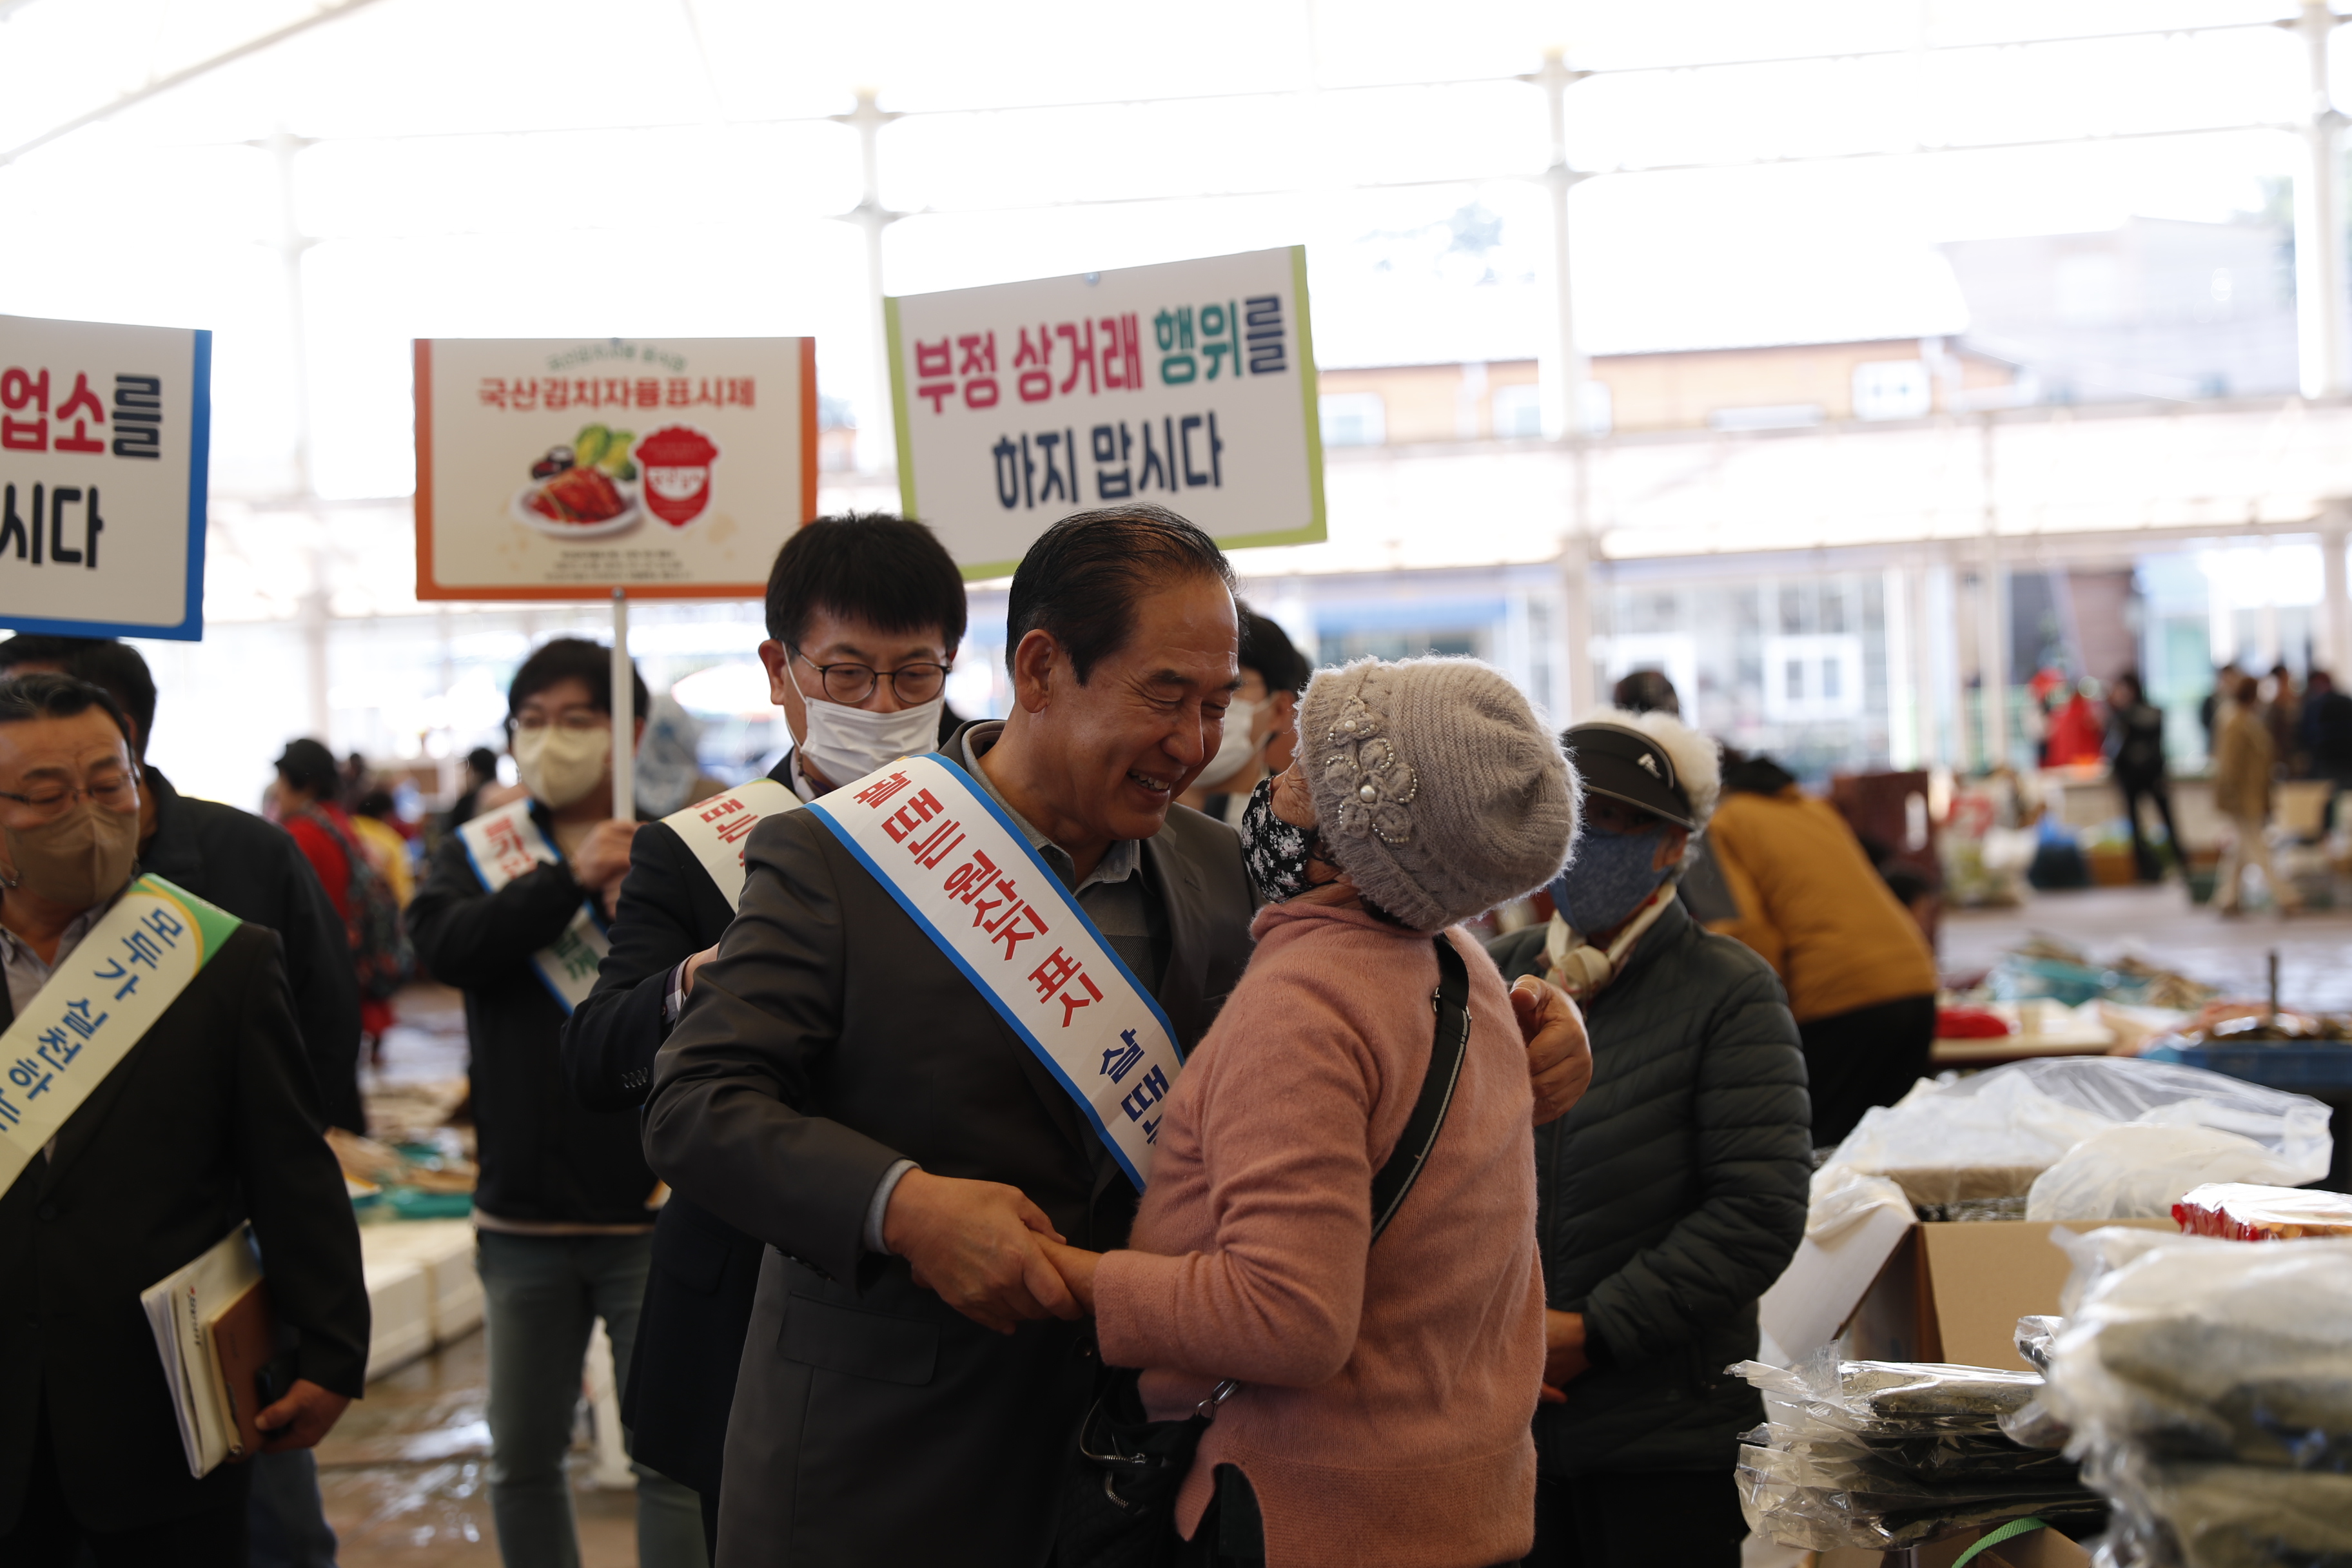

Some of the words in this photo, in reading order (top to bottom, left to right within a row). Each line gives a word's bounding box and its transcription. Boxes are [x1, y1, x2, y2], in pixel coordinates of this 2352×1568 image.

[915, 329, 1001, 415] 부정
[1013, 312, 1144, 404] 상거래
[1153, 294, 1288, 386] 행위를
[0, 366, 162, 460] 업소를
[992, 428, 1079, 509] 하지
[1092, 411, 1223, 500] 맙시다
[0, 481, 104, 570] 시다
[853, 770, 912, 809] 팔
[881, 788, 966, 870] 때는
[943, 849, 1049, 961] 원산지
[93, 907, 184, 1002] 모두가
[1028, 946, 1104, 1028] 표시
[1099, 1028, 1145, 1084] 살
